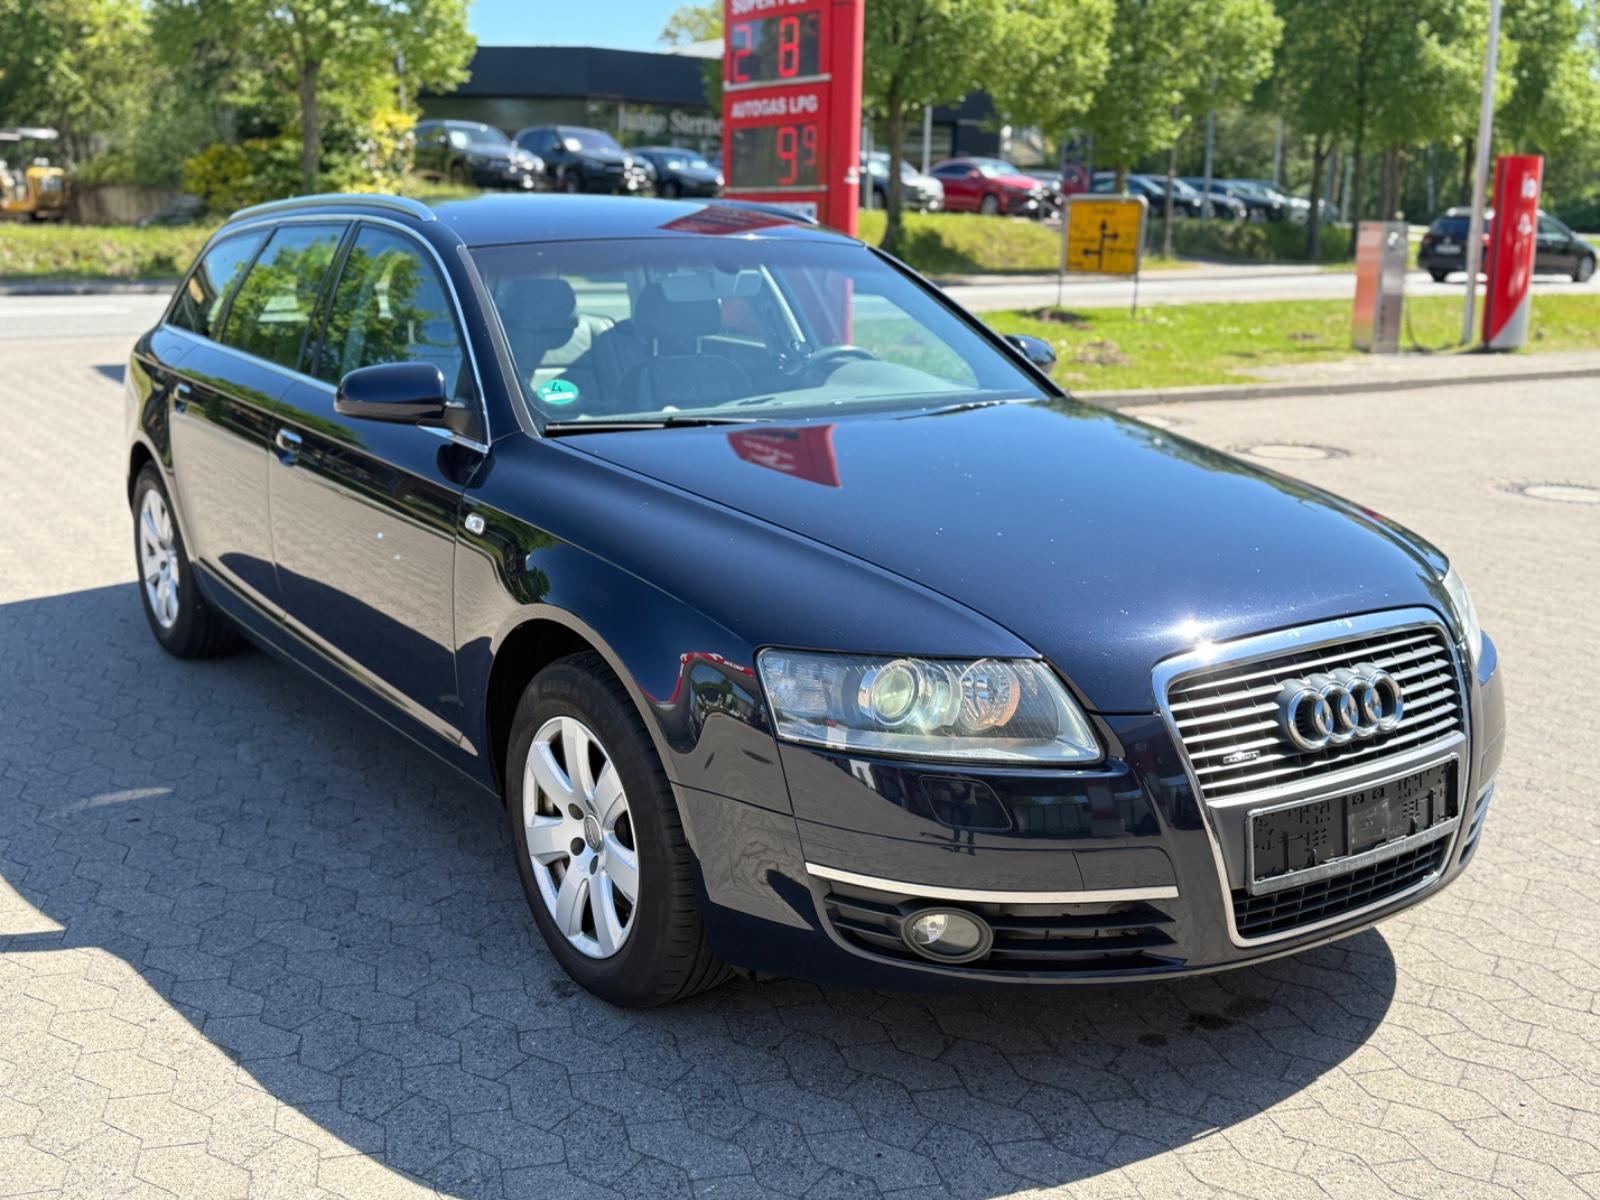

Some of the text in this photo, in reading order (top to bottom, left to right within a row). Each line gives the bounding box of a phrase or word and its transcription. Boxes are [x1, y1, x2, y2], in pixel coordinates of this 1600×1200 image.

[731, 94, 818, 119] AUTOGAS LPG
[551, 381, 563, 393] 4
